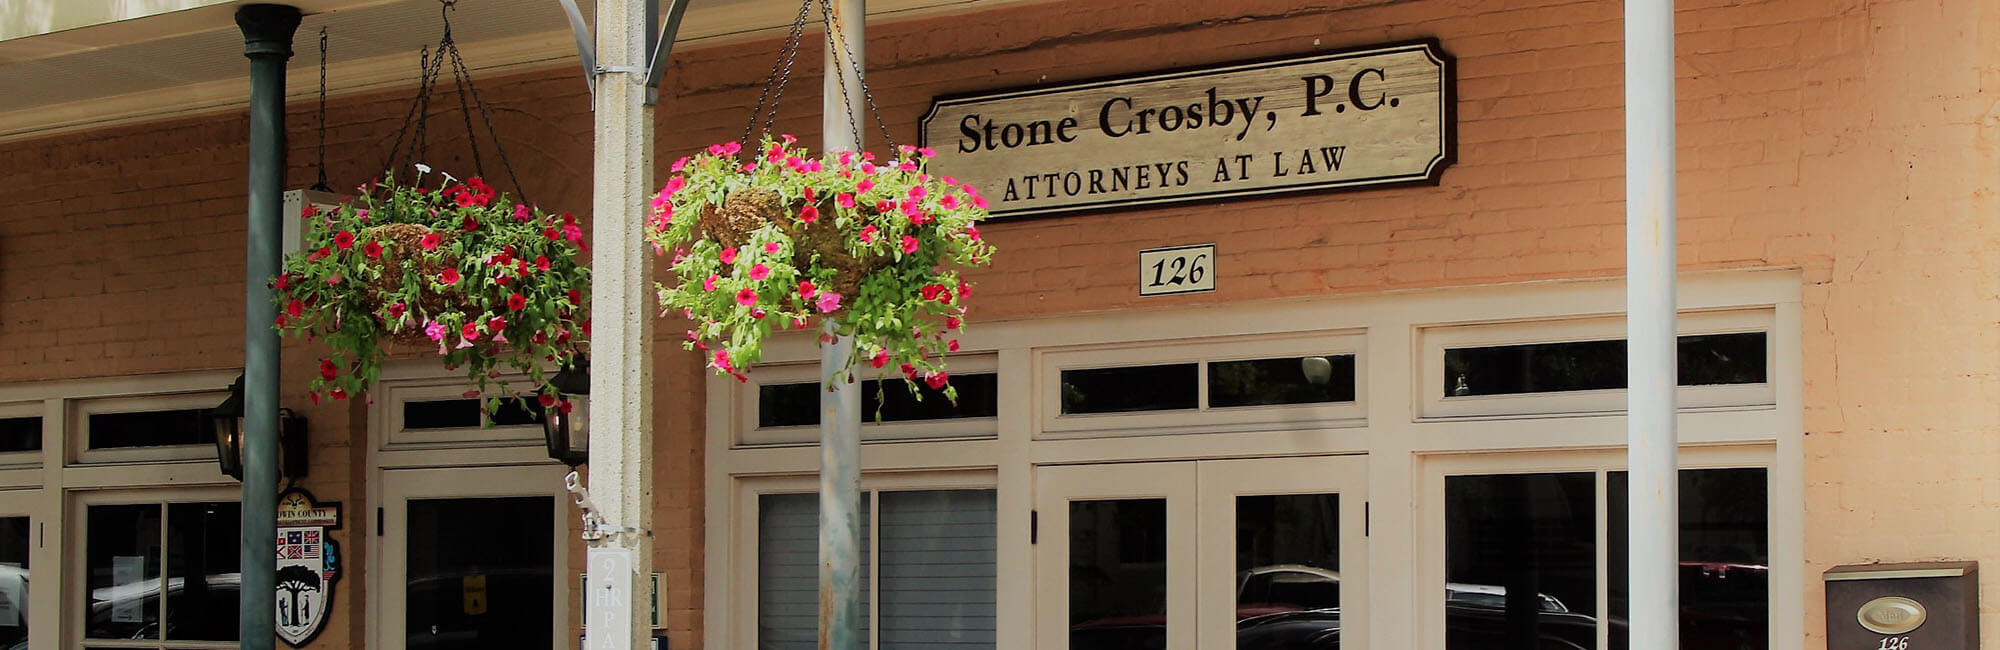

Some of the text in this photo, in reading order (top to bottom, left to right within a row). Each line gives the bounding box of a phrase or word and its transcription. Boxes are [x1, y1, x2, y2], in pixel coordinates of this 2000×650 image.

[957, 67, 1400, 154] Stone Crosby, P.C.
[1003, 145, 1348, 202] ATTORNEYS AT LAW
[1149, 254, 1207, 288] 126
[297, 509, 326, 518] COUNTY
[603, 558, 616, 581] 2
[595, 588, 622, 607] HR
[1878, 637, 1909, 650] 126
